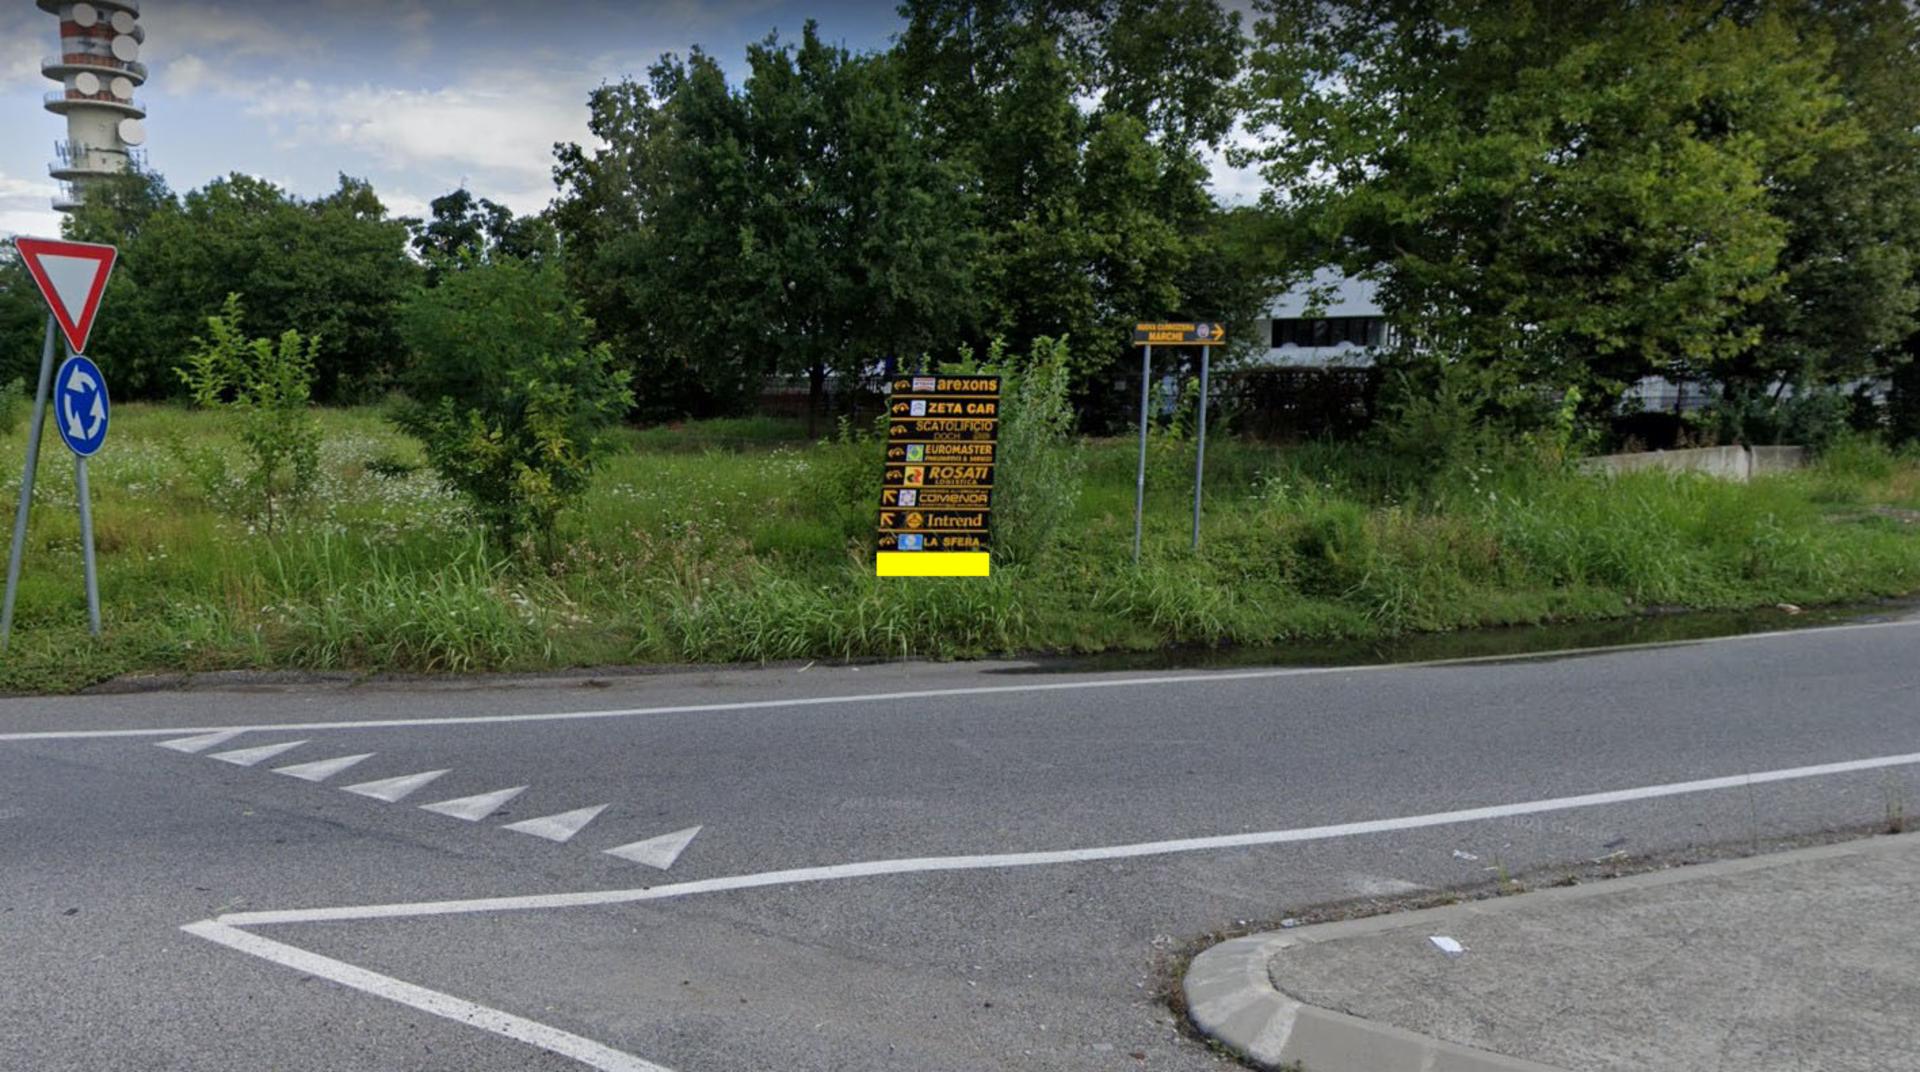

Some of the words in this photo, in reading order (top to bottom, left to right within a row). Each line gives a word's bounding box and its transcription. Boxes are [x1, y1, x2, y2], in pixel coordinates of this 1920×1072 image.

[937, 379, 997, 391] arexons
[928, 402, 962, 414] ZETA
[967, 403, 995, 414] CAR
[916, 421, 993, 431] SCATOLIFICIO
[925, 444, 993, 455] EUROMASTER
[929, 466, 988, 479] ROSATI
[928, 513, 983, 527] Intrend
[924, 537, 938, 547] LA
[943, 537, 980, 547] SFERA
